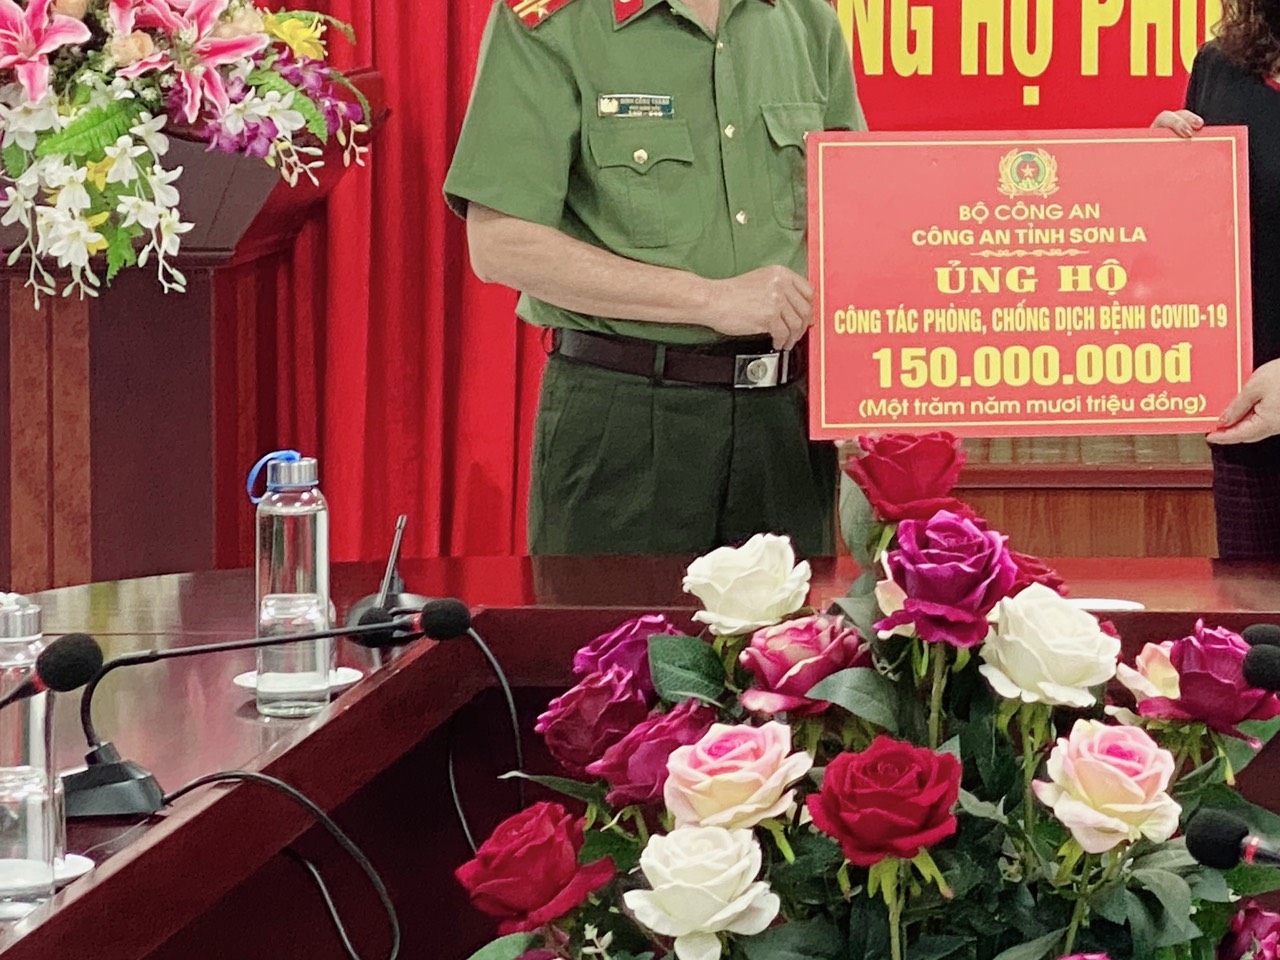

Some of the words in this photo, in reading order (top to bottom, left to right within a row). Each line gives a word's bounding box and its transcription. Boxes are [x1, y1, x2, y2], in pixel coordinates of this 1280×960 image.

[959, 201, 990, 225] BỘ
[994, 201, 1064, 221] CÔNG
[1068, 203, 1101, 220] AN
[912, 226, 974, 246] CÔNG
[979, 230, 1010, 245] AN
[1015, 223, 1065, 244] TỈNH
[1069, 227, 1115, 244] SƠN
[1119, 227, 1148, 243] LA
[934, 259, 1039, 294] ỦNG
[1057, 258, 1128, 296] HỘ
[834, 304, 882, 334] CÔNG
[886, 303, 919, 333] TÁC
[923, 302, 988, 335] PHÒNG,
[992, 298, 1050, 333] CHỐNG
[1055, 306, 1095, 336] DỊCH
[1100, 300, 1146, 336] BỆNH
[1150, 303, 1228, 330] COVID-19
[872, 342, 1192, 388] 150.000.000đ
[858, 397, 909, 419] (Một
[914, 398, 965, 416] trăm
[970, 397, 1021, 415] năm
[1026, 394, 1082, 414] mươi
[1086, 393, 1136, 416] triệu
[1140, 390, 1207, 415] đồng)
